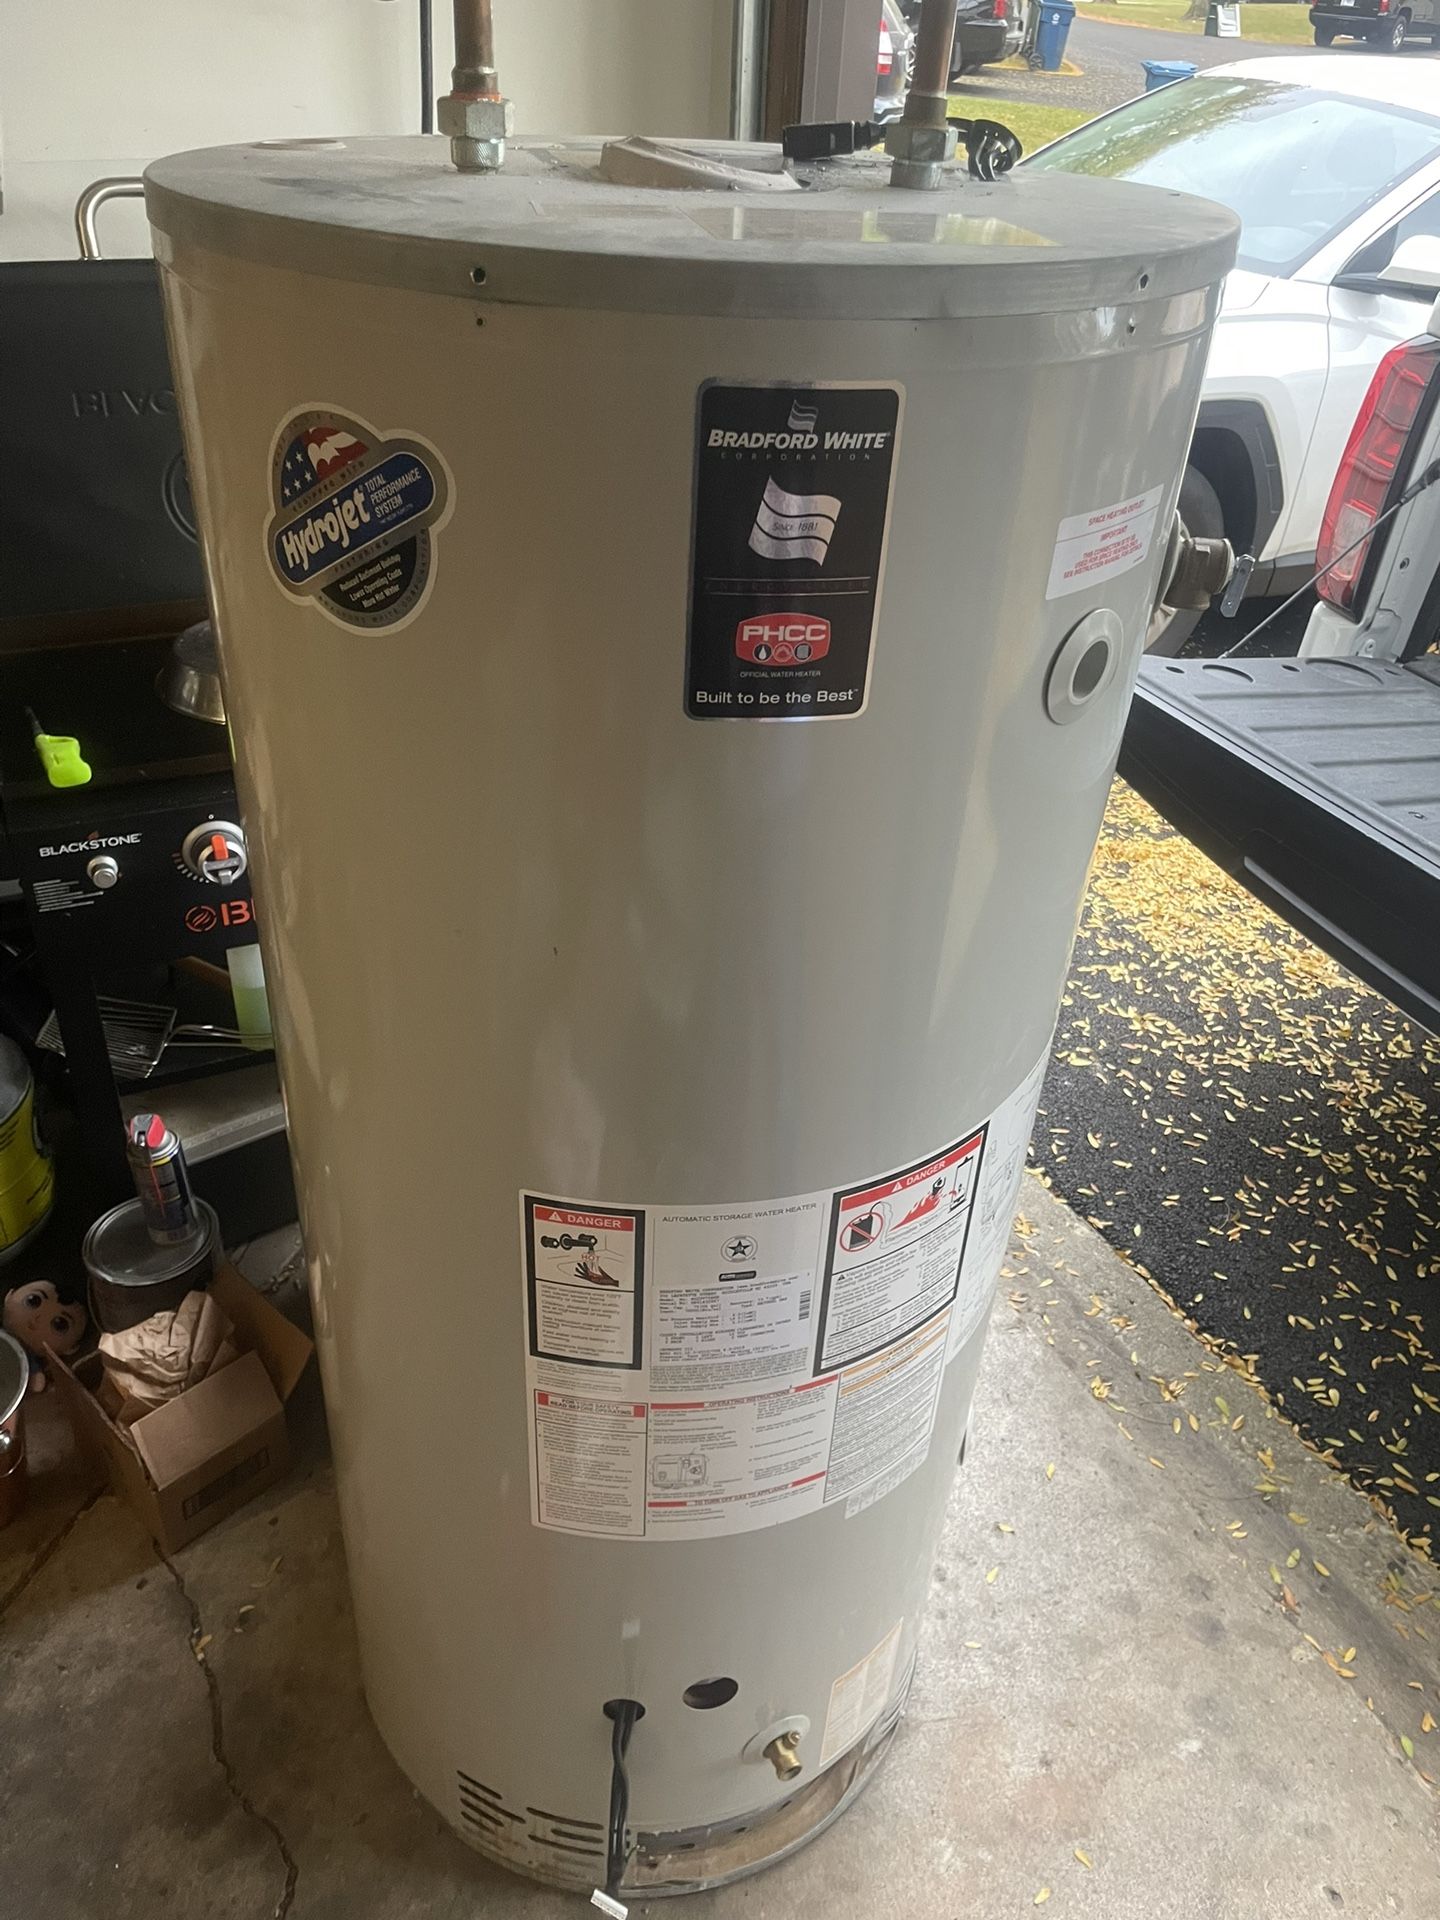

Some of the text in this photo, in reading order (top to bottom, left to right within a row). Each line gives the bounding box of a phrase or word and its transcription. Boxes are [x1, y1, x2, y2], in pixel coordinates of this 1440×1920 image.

[708, 429, 887, 449] BRADFORD WHITE
[721, 452, 870, 461] CORPORATION
[364, 473, 386, 493] TOTAL
[370, 467, 421, 505] PERFORMANCE
[375, 495, 403, 518] SYSTEM
[281, 487, 371, 571] Hydrojet
[798, 522, 819, 531] 1881
[349, 588, 365, 601] Lower
[363, 576, 389, 595] Operating
[385, 584, 400, 597] Water
[742, 625, 827, 642] PHCC
[740, 671, 769, 679] OFFICIAL
[794, 670, 821, 678] HEATER
[696, 689, 854, 705] Built to be the Best
[40, 833, 141, 857] BLACKSTONE
[906, 1160, 946, 1186] DANGER
[567, 1214, 622, 1229] DANGER
[713, 1213, 752, 1222] STORAGE
[755, 1209, 784, 1218] WATER
[785, 1203, 817, 1213] HEATER
